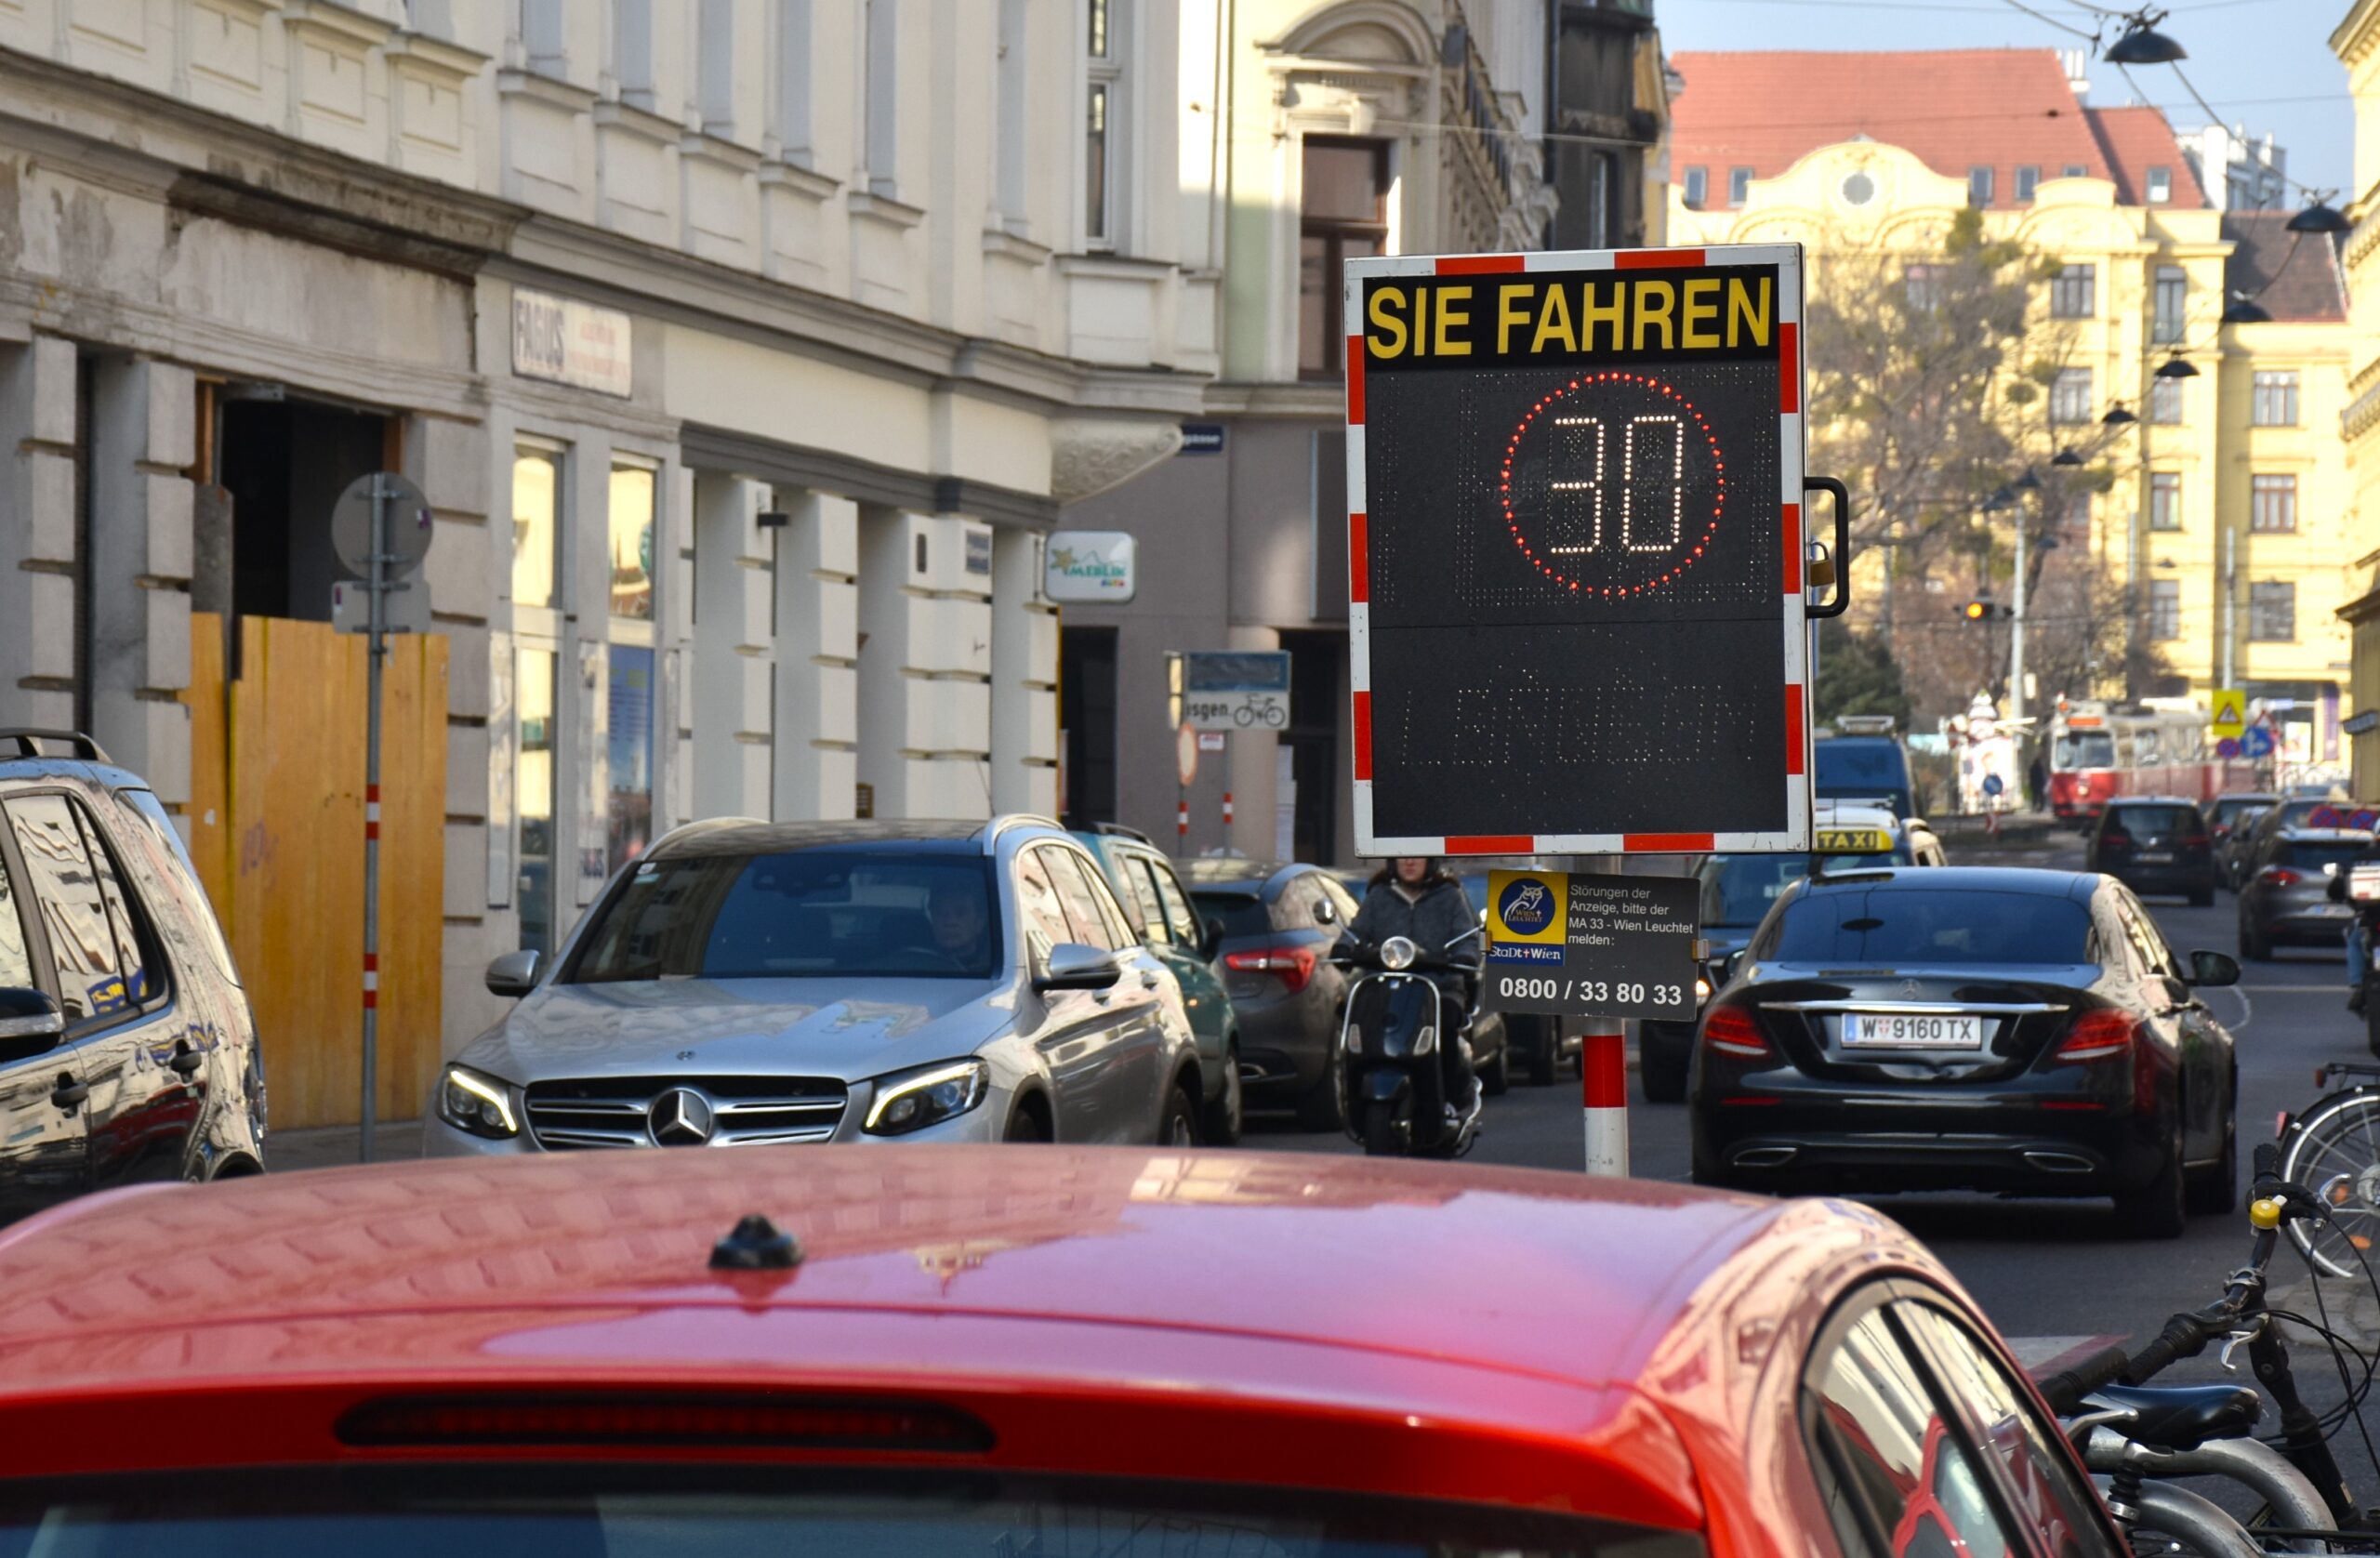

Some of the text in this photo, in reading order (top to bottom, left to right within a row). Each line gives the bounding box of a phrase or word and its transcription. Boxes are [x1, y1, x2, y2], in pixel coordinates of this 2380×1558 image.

[1367, 277, 1771, 360] SIE FAHREN
[1550, 415, 1685, 554] 30
[1820, 833, 1875, 848] TAXI
[1570, 885, 1651, 900] Störungen der
[1569, 900, 1670, 916] Anzeige, bitte der
[1568, 918, 1587, 929] MA
[1590, 918, 1604, 930] 33
[1613, 918, 1642, 931] Wien
[1645, 920, 1694, 934] Leuchtet
[1568, 933, 1615, 945] melden:
[1500, 977, 1682, 1005] 0800 / 33 80 33
[1861, 1018, 1876, 1038] W
